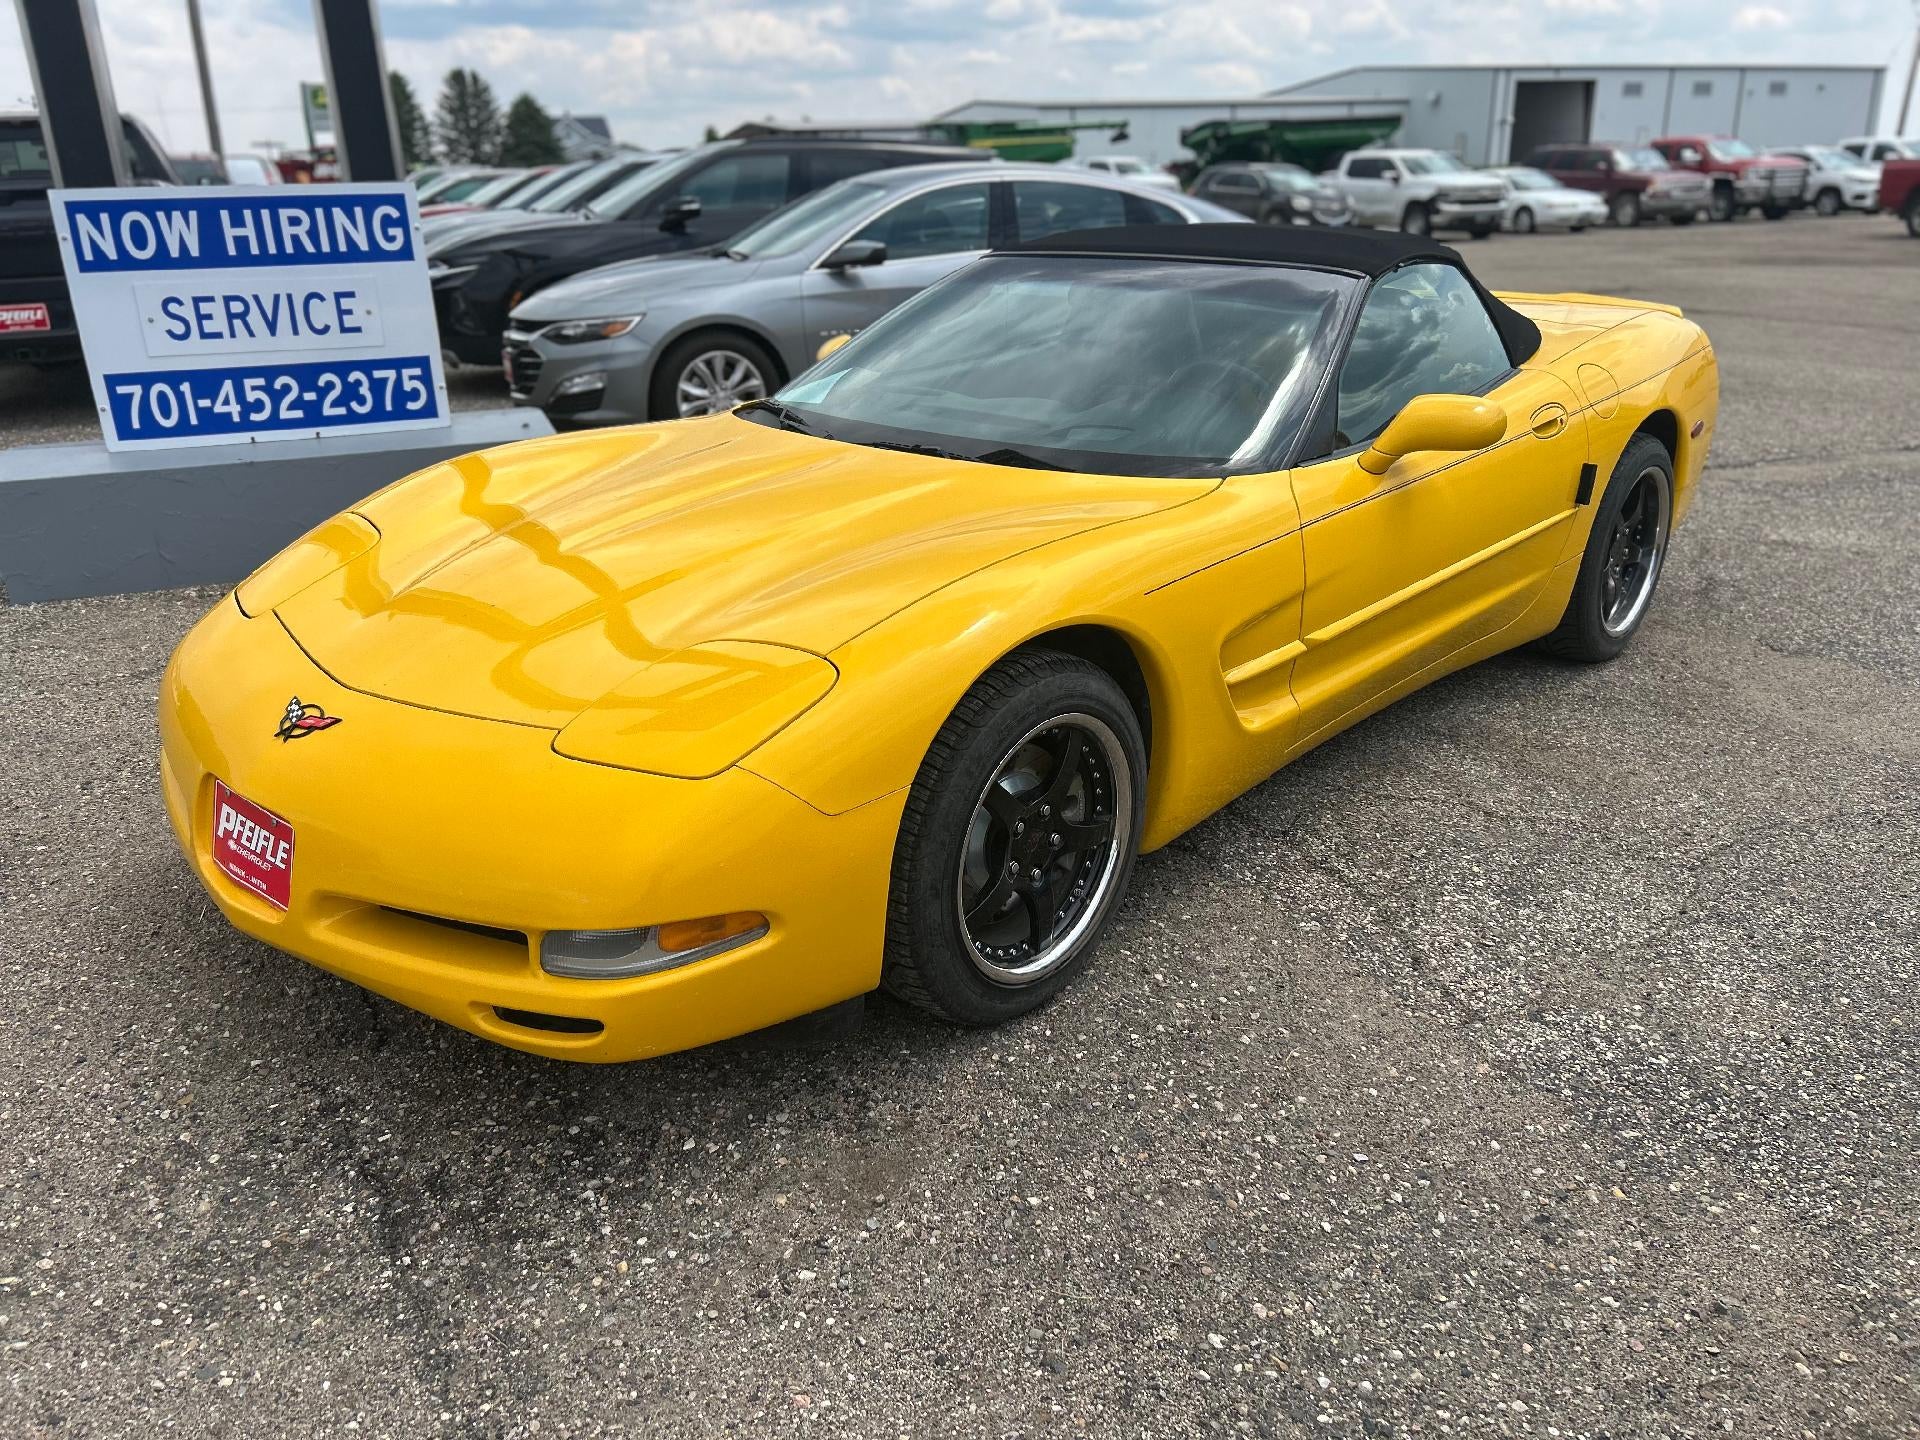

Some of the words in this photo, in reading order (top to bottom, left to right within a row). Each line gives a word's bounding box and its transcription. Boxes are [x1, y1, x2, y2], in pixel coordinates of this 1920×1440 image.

[75, 210, 200, 262] NOW
[220, 205, 406, 256] HIRING
[161, 291, 363, 341] SERVICE
[116, 367, 428, 430] 701-452-2375
[217, 802, 290, 870] PFEIFLE
[236, 845, 273, 871] CHEVROLET
